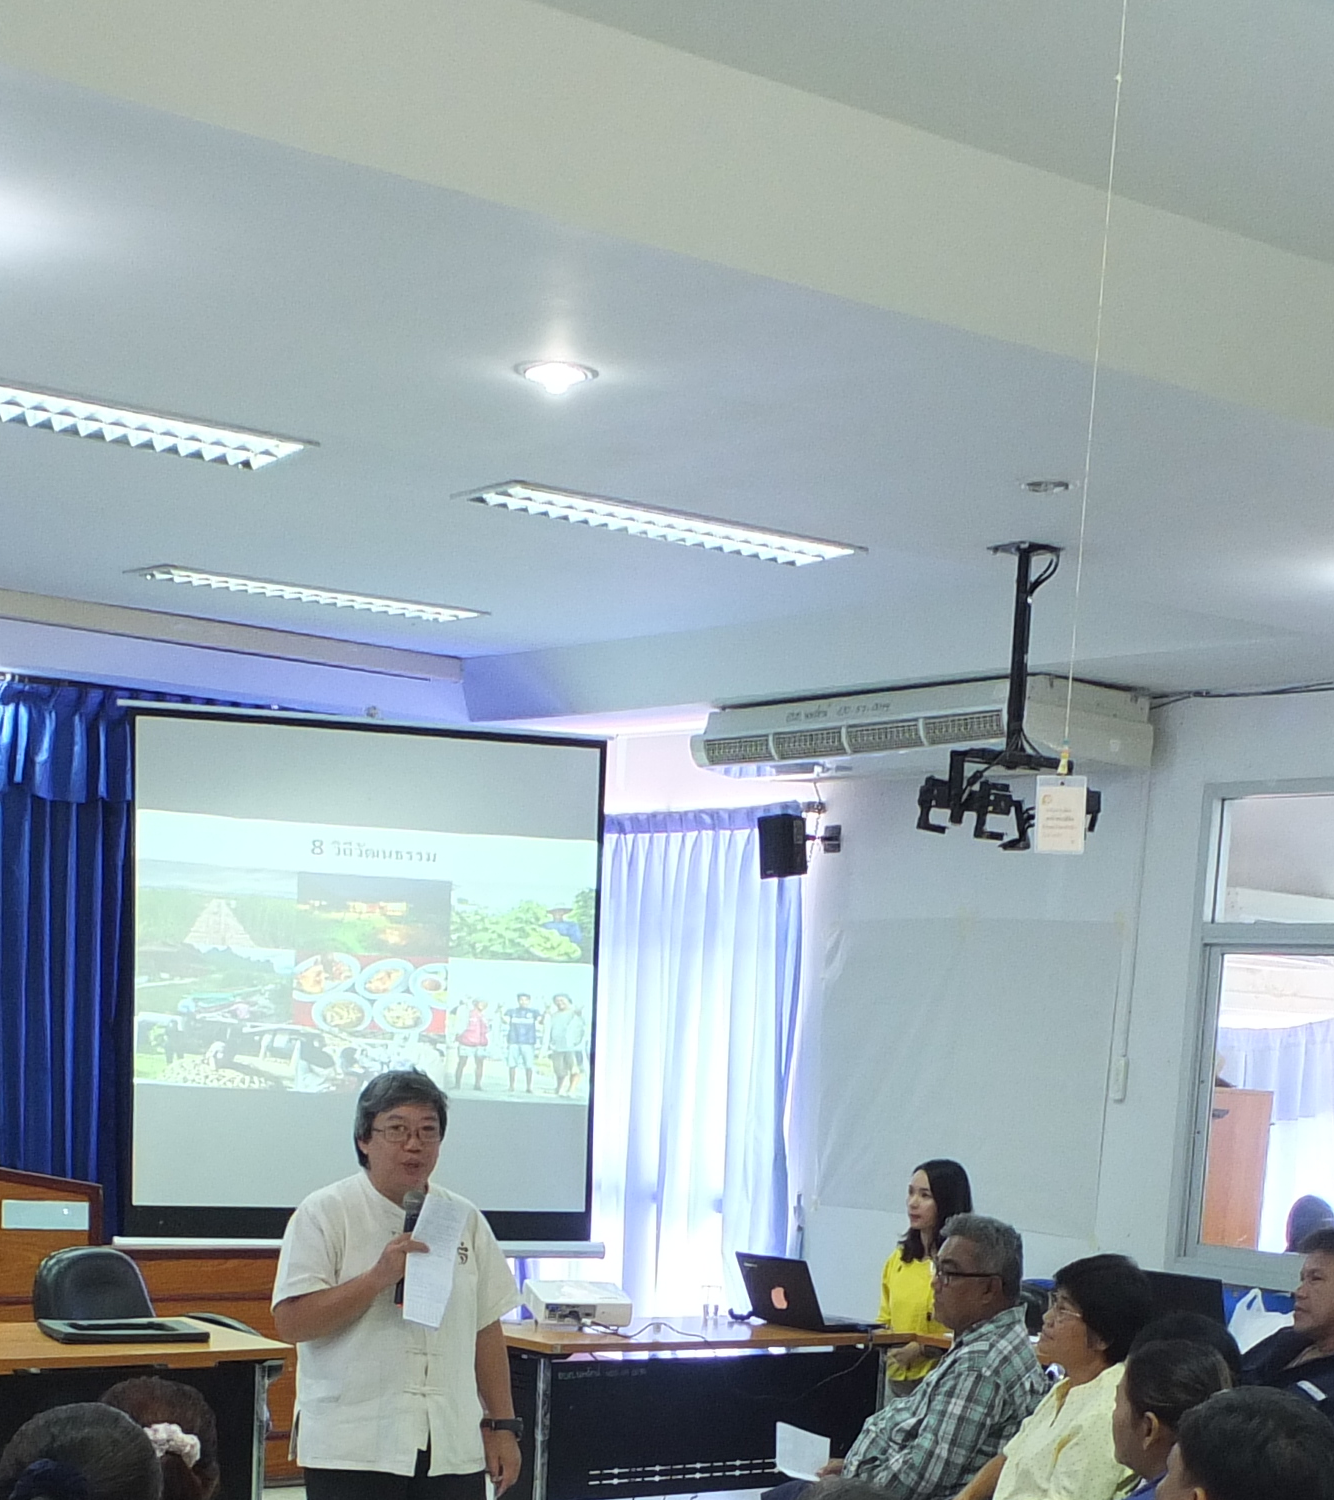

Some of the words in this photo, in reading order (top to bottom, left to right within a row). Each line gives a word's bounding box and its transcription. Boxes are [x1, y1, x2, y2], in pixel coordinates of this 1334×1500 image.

[310, 839, 324, 856] 8
[331, 840, 437, 862] วิถีวัฒนธรรม
